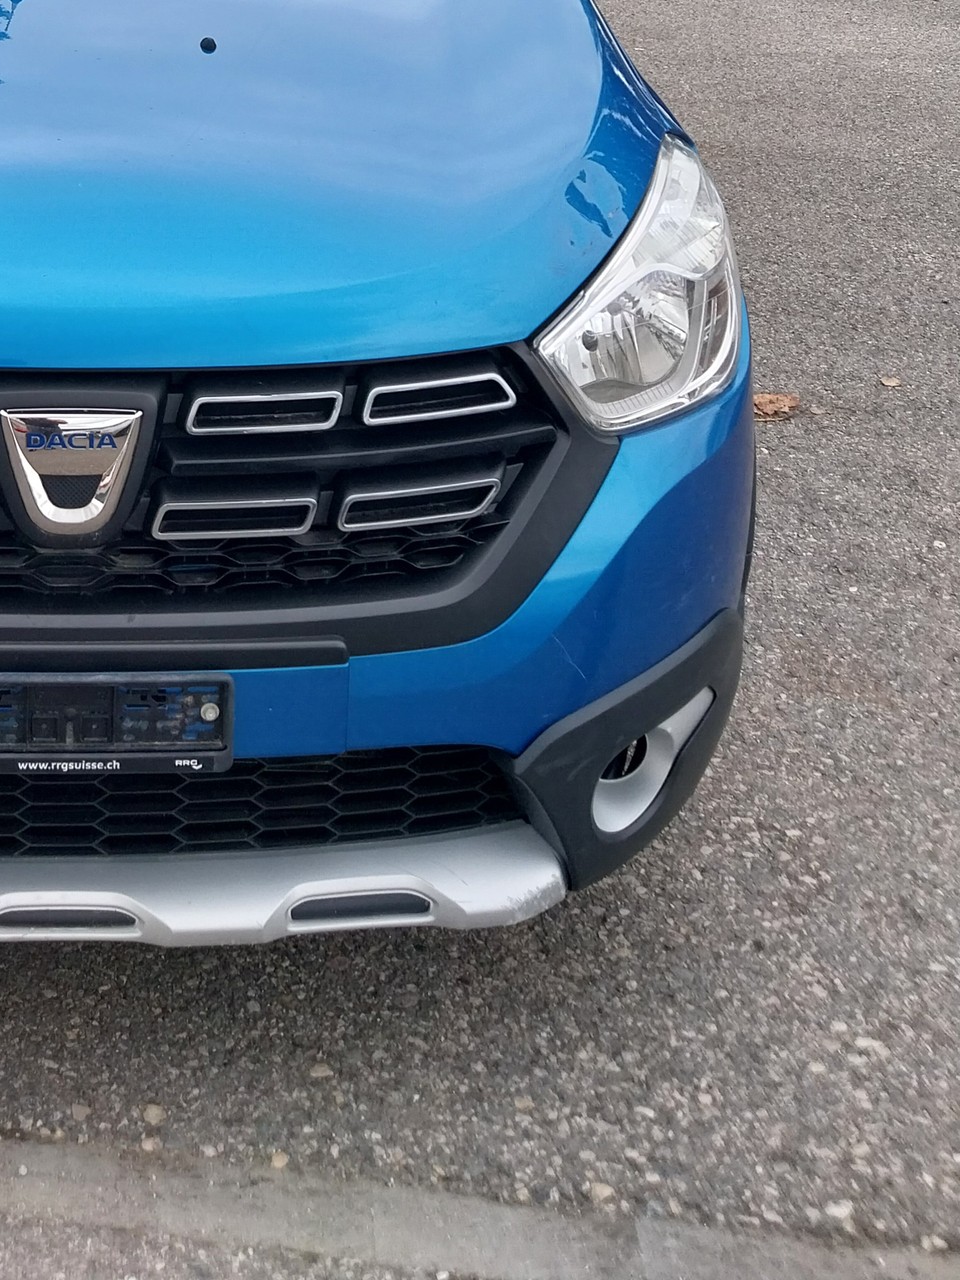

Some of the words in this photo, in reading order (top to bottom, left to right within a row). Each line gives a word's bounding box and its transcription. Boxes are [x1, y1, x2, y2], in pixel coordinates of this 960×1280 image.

[25, 432, 117, 450] DACIA
[18, 760, 121, 771] www.rrgsuisse.ch
[175, 758, 201, 768] RRG
